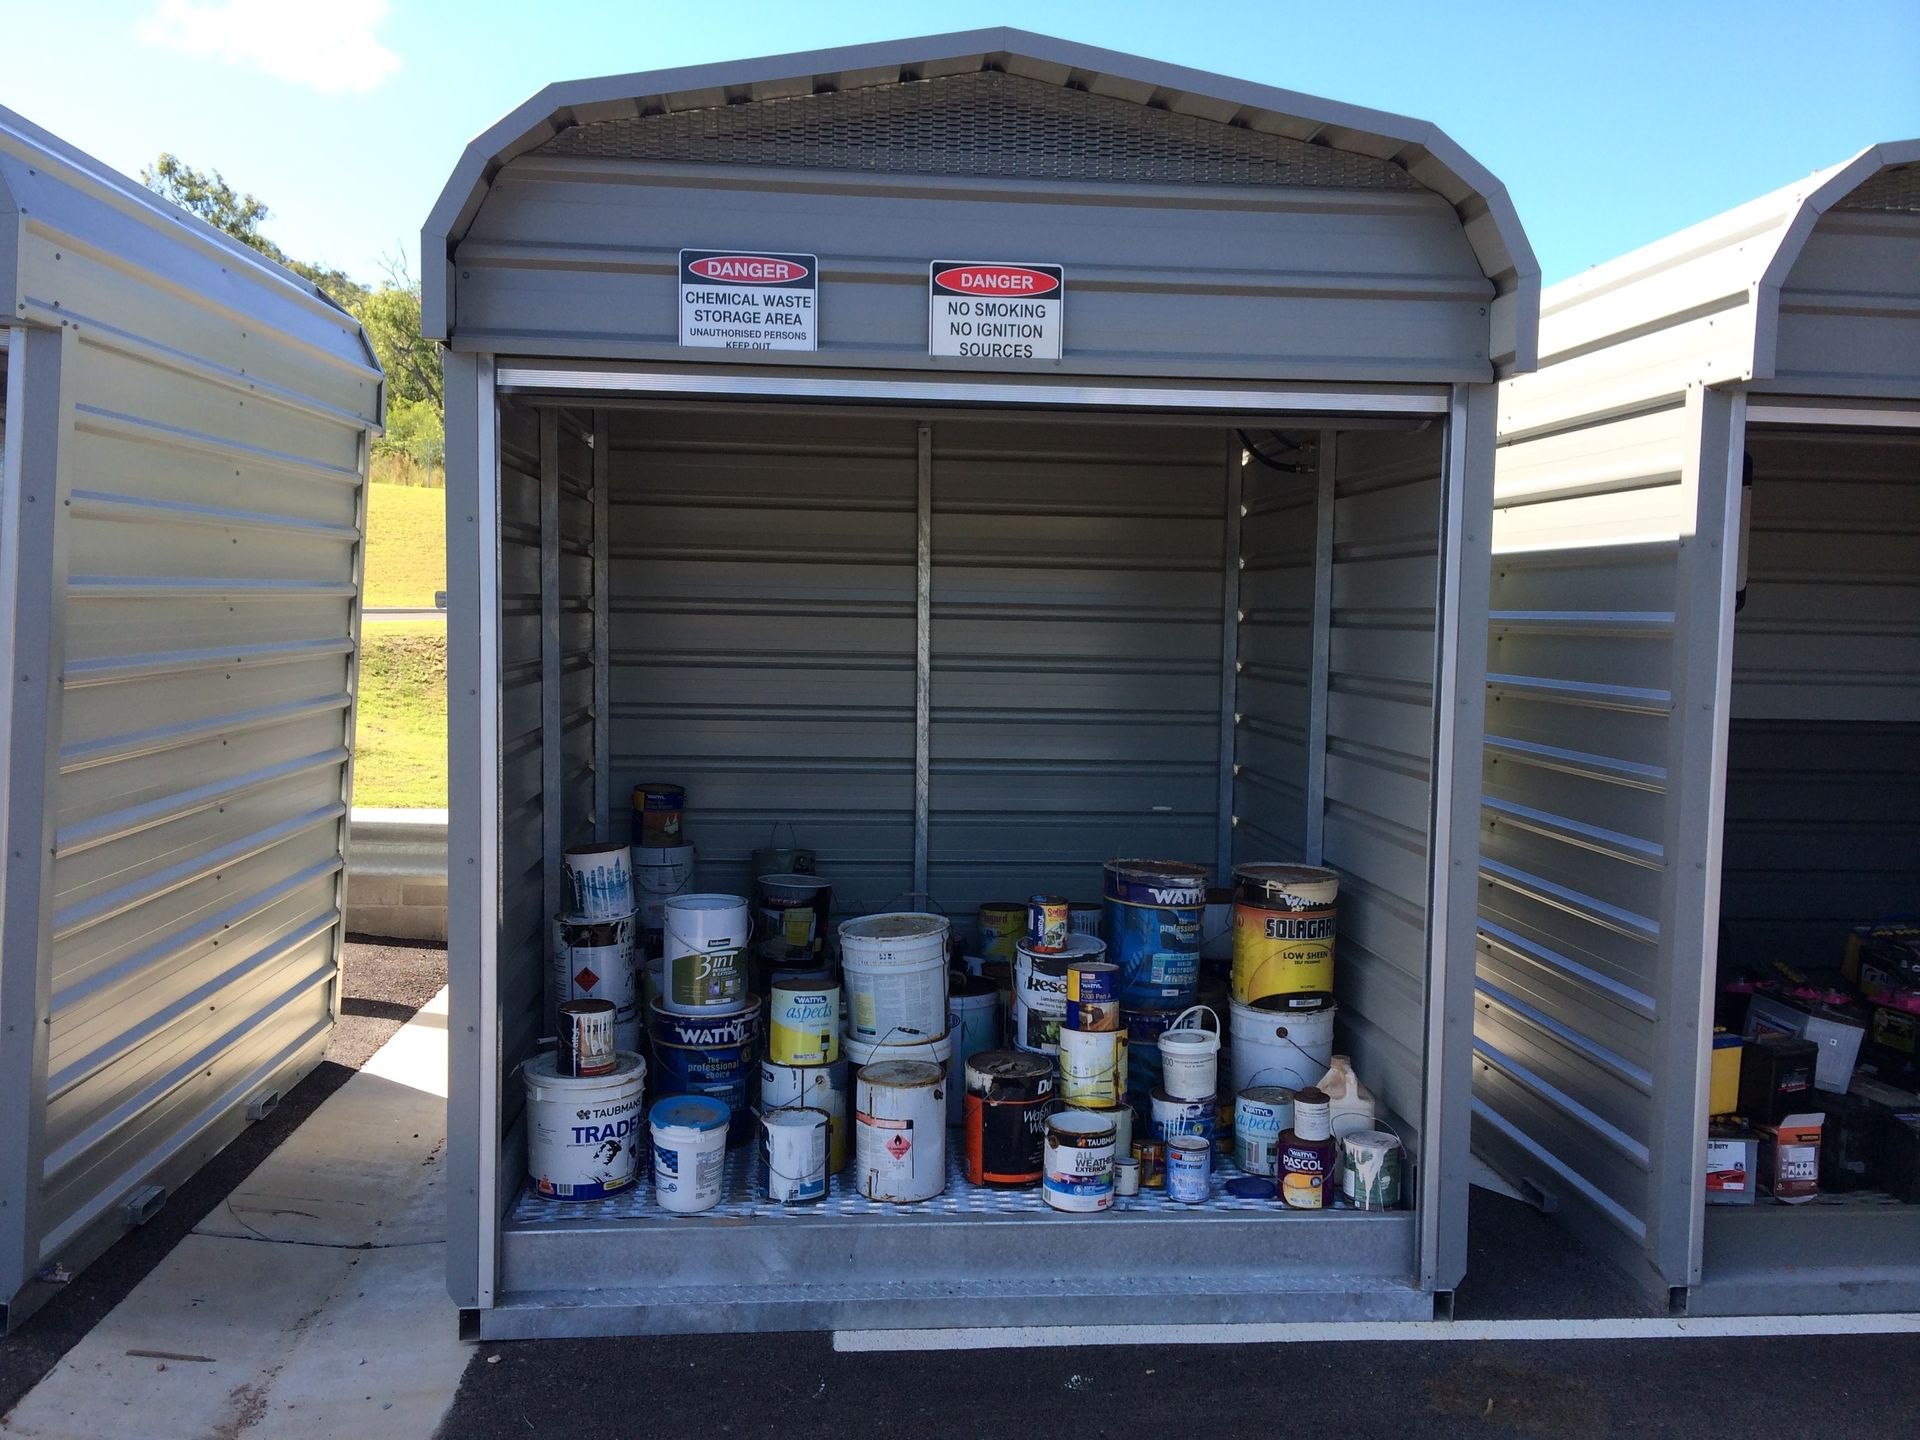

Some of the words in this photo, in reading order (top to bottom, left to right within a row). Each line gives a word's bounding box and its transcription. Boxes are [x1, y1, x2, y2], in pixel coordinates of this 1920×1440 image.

[708, 261, 789, 278] DANGER
[961, 273, 1033, 289] DANGER
[685, 291, 759, 306] CHEMICAL
[762, 294, 811, 308] WASTE
[694, 309, 761, 324] STORAGE
[764, 312, 802, 326] AREA
[948, 302, 970, 316] NO
[975, 302, 1046, 318] SMOKING
[689, 327, 762, 339] UNAUTHORISED
[764, 330, 807, 341] PERSONS
[950, 322, 972, 336] NO
[977, 323, 1043, 338] IGNITION
[725, 341, 750, 350] KEEP
[752, 342, 771, 351] OUT
[959, 342, 1033, 359] SOURCES
[1148, 888, 1206, 904] WATTYL
[1283, 952, 1304, 960] LOW
[1306, 951, 1328, 960] SHEEN
[786, 1003, 832, 1023] aspects
[688, 1060, 739, 1073] professional
[708, 1056, 720, 1064] The
[592, 1096, 642, 1119] TAUBMANS
[1076, 1151, 1094, 1160] ALL
[1290, 1149, 1315, 1159] WATTYL
[1075, 1165, 1107, 1173] EXTERIOR
[1283, 1154, 1323, 1171] PASCOL
